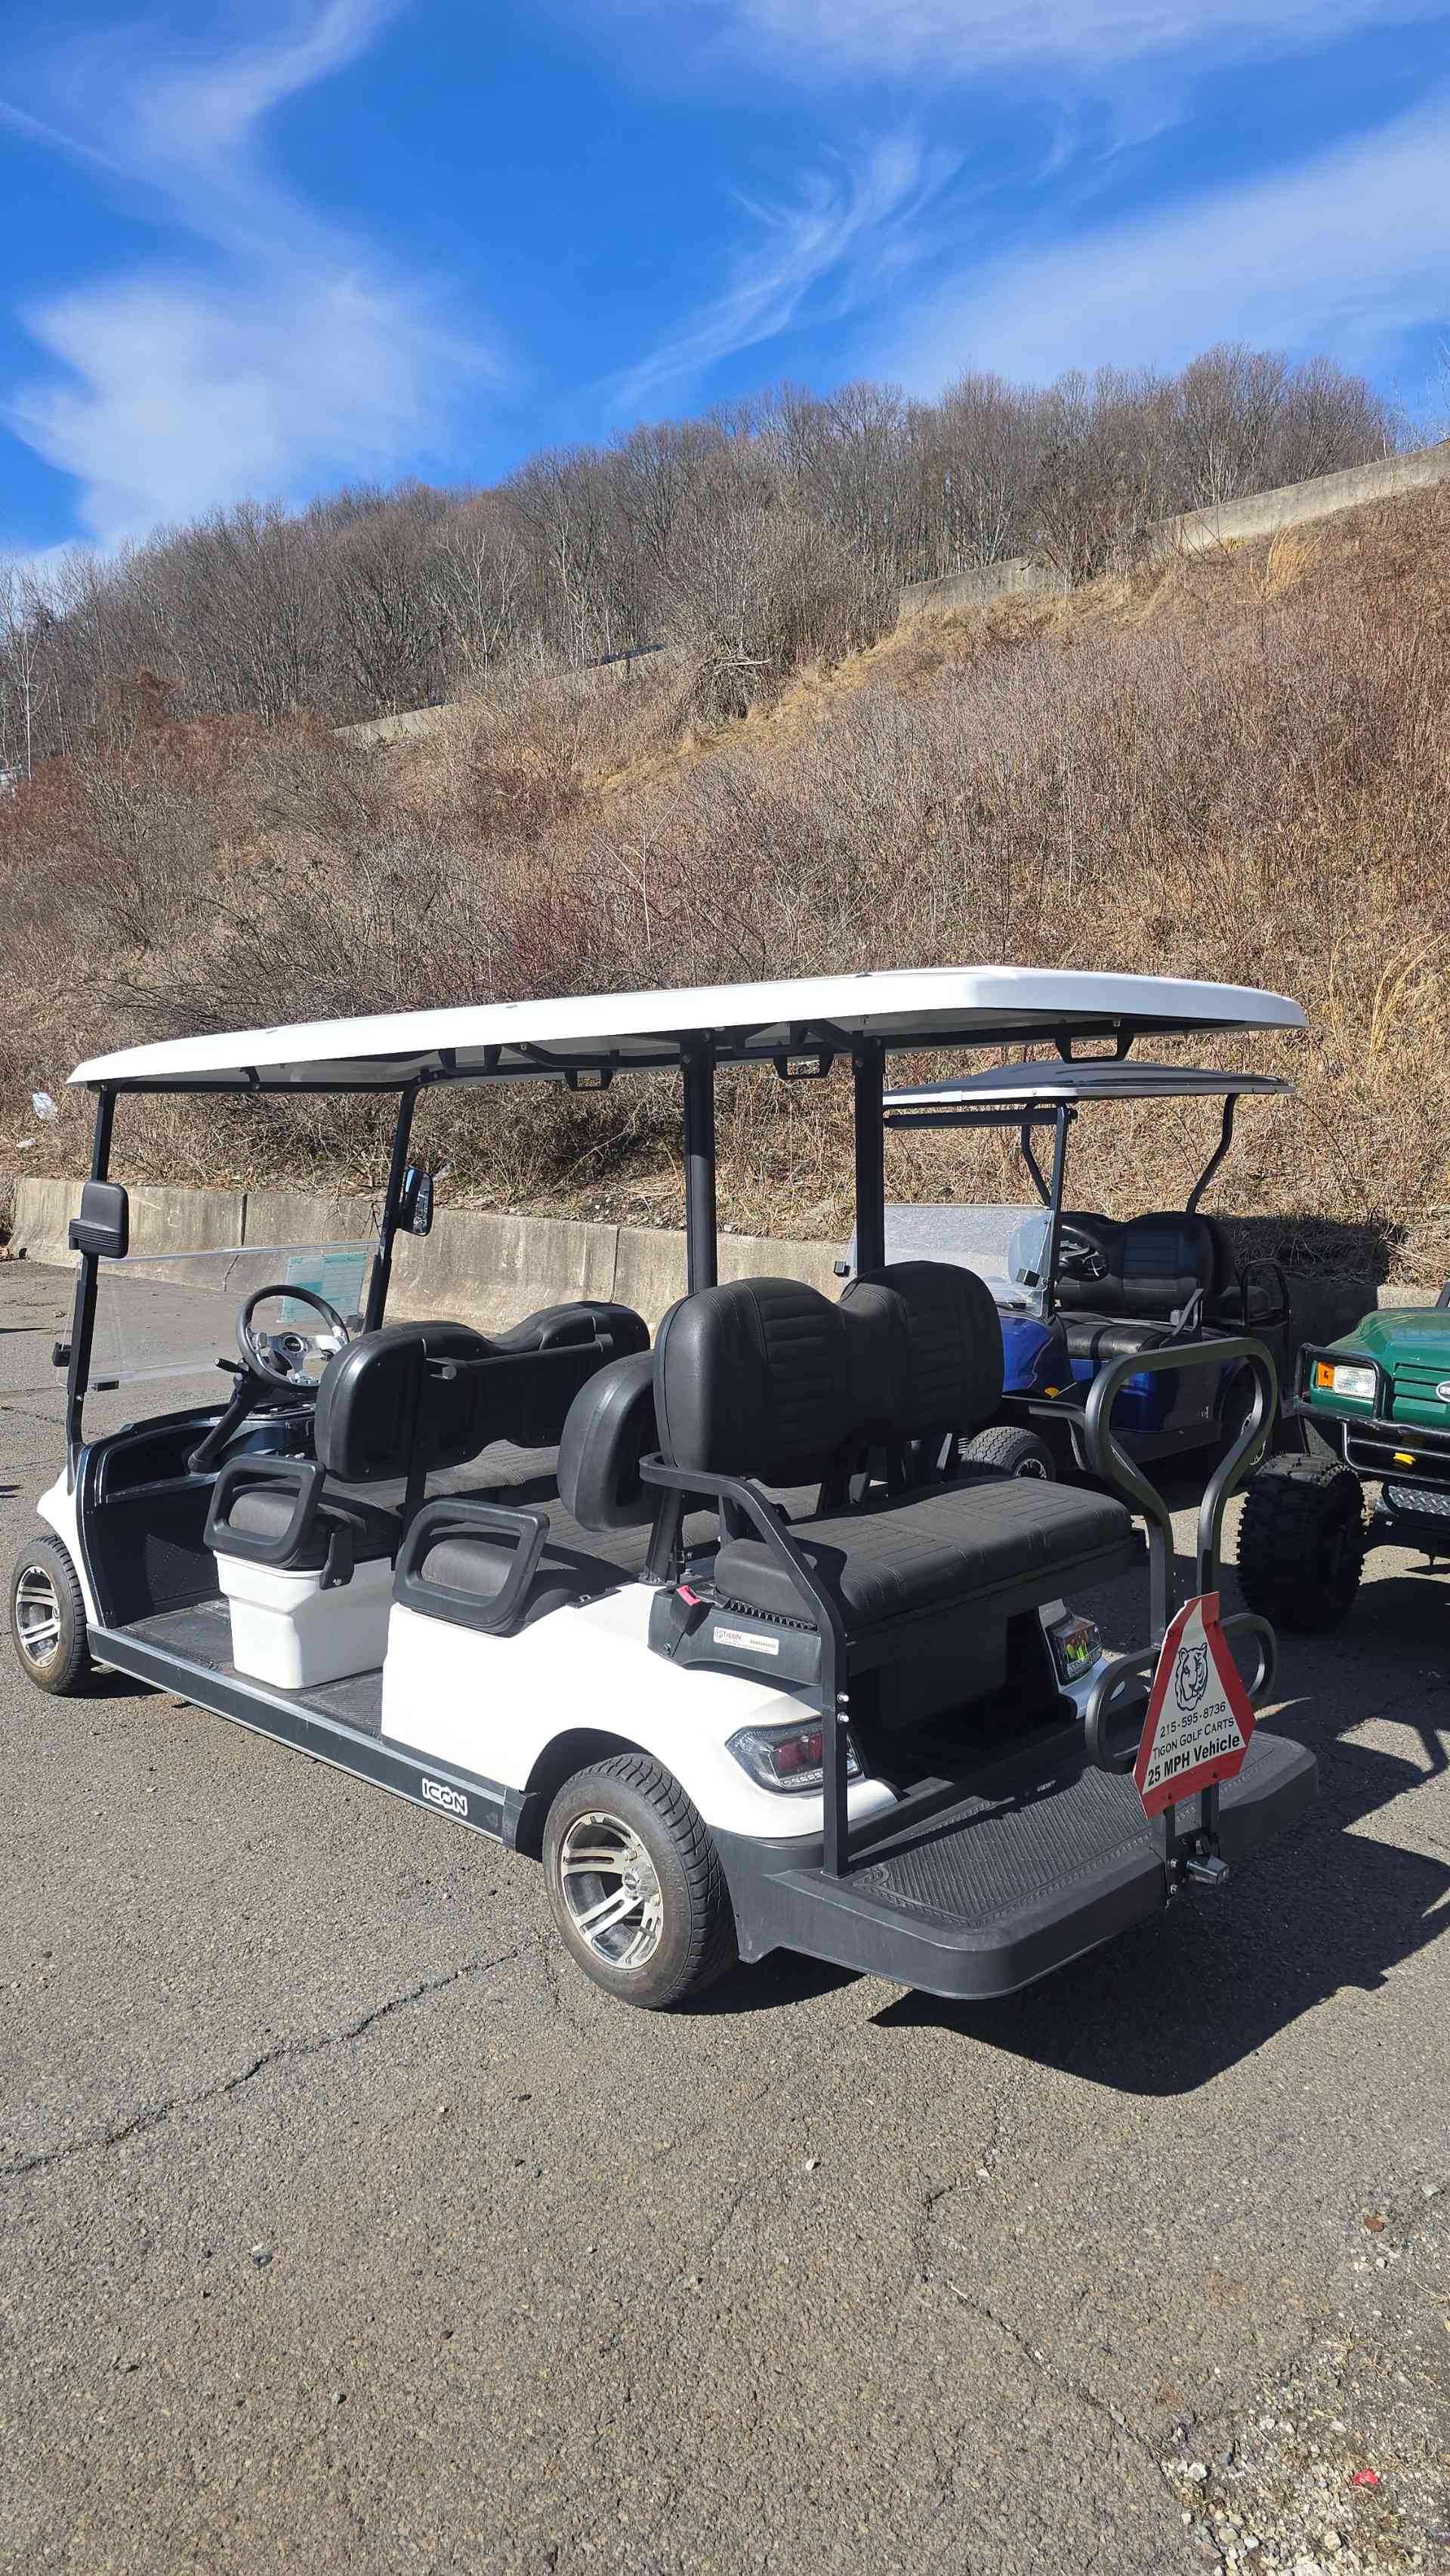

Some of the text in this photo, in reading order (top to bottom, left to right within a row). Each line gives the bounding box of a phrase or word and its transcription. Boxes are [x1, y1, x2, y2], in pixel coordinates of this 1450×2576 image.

[1152, 1717, 1234, 1759] TIGON GOLF CARTS
[1160, 1701, 1226, 1738] 215-595-8736
[1148, 1734, 1239, 1787] 25 MPH Vehicle
[422, 1778, 467, 1816] ICON
